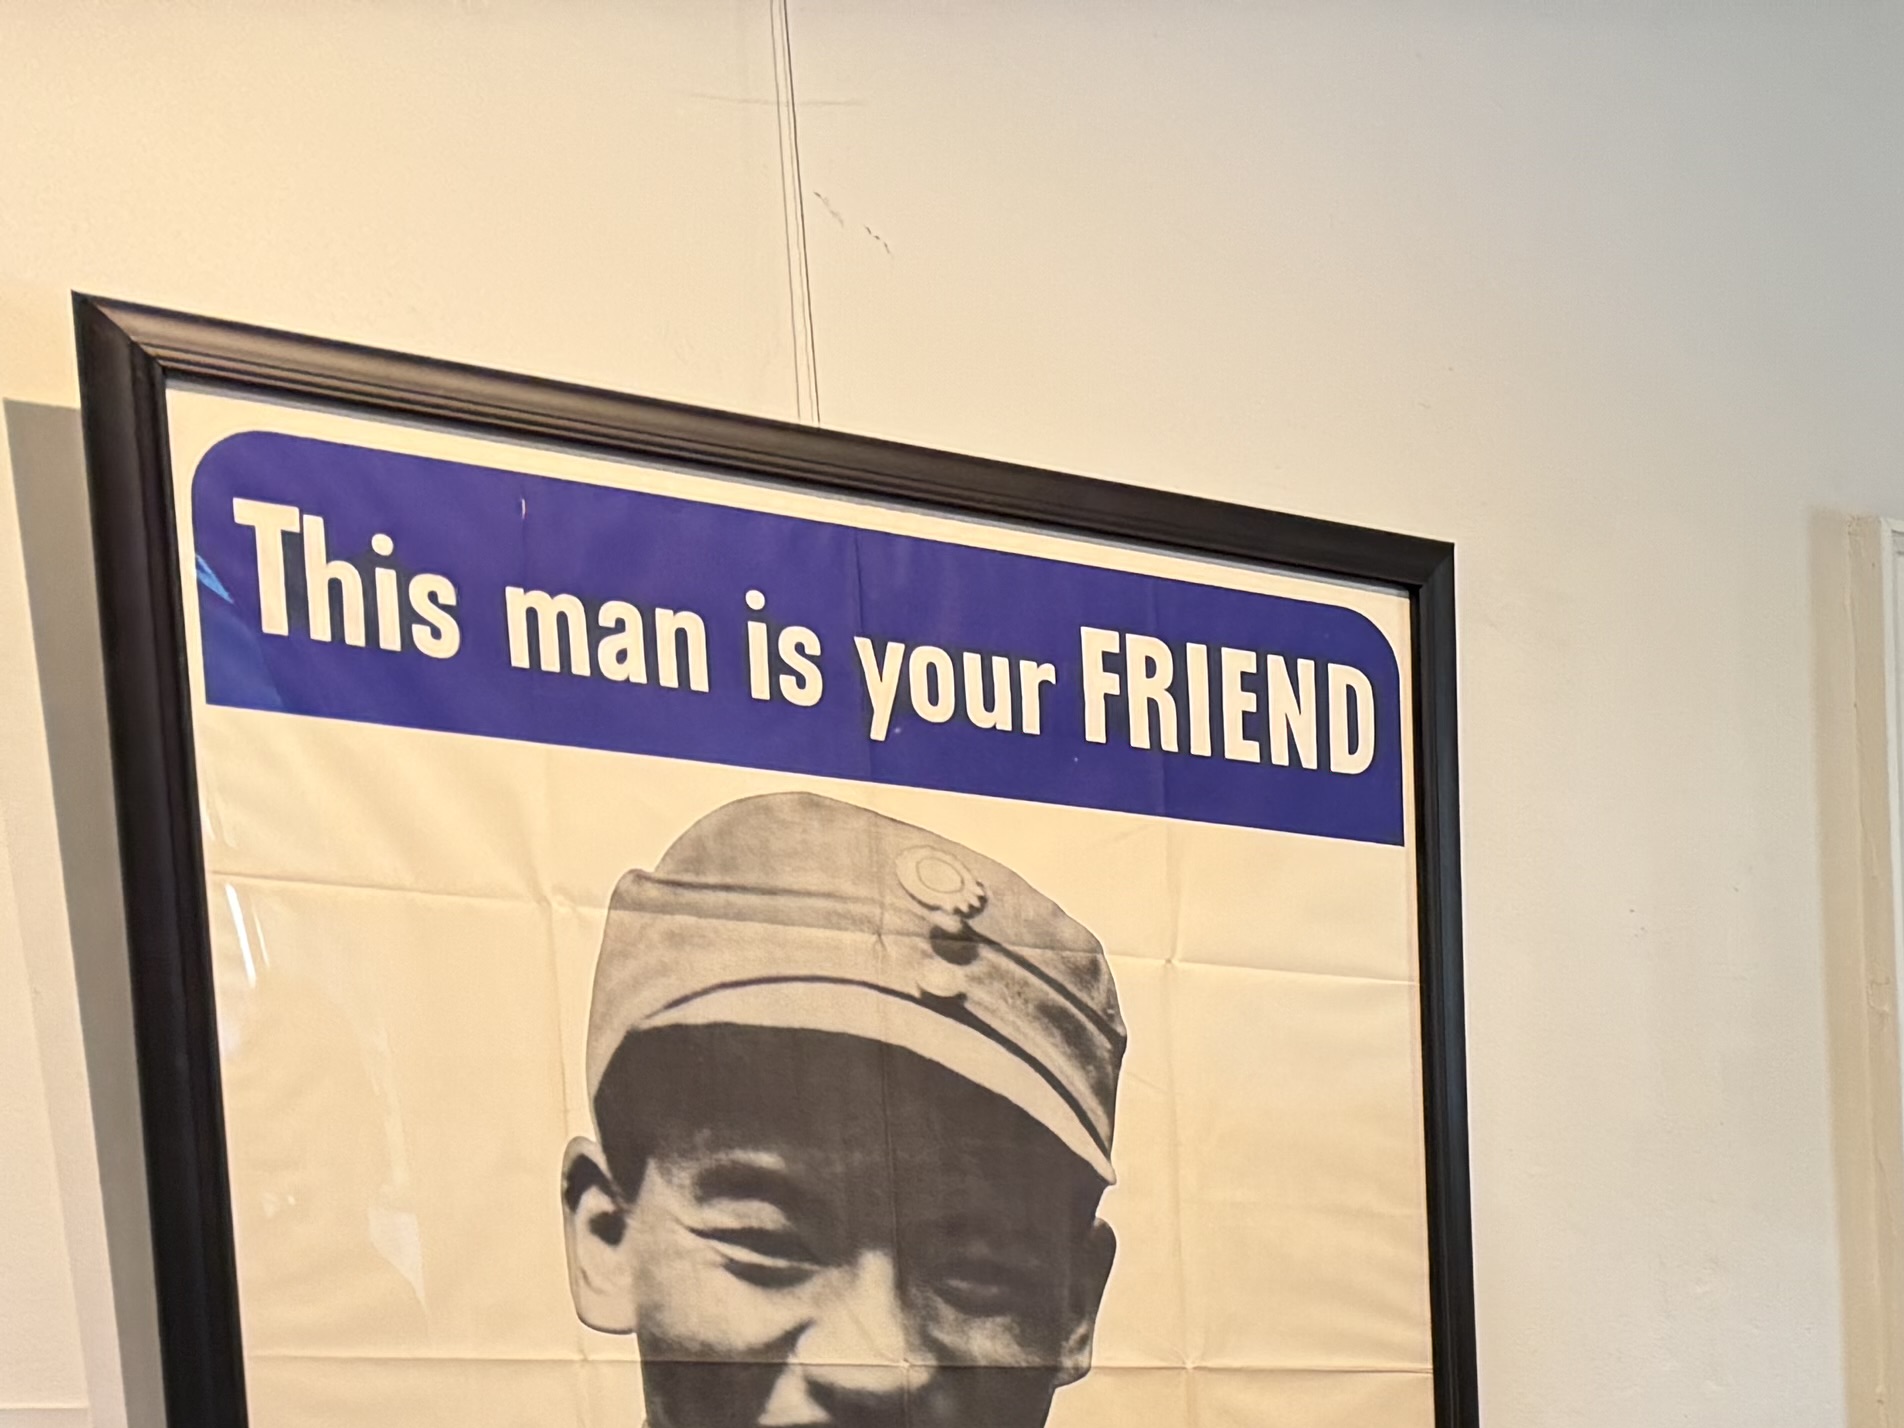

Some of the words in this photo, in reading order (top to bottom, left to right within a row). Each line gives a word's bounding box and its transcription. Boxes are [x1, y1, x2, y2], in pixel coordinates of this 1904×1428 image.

[232, 497, 461, 660] This
[505, 586, 709, 694] man
[745, 589, 824, 707] is
[853, 635, 1056, 742] your
[1080, 625, 1376, 776] FRIEND
